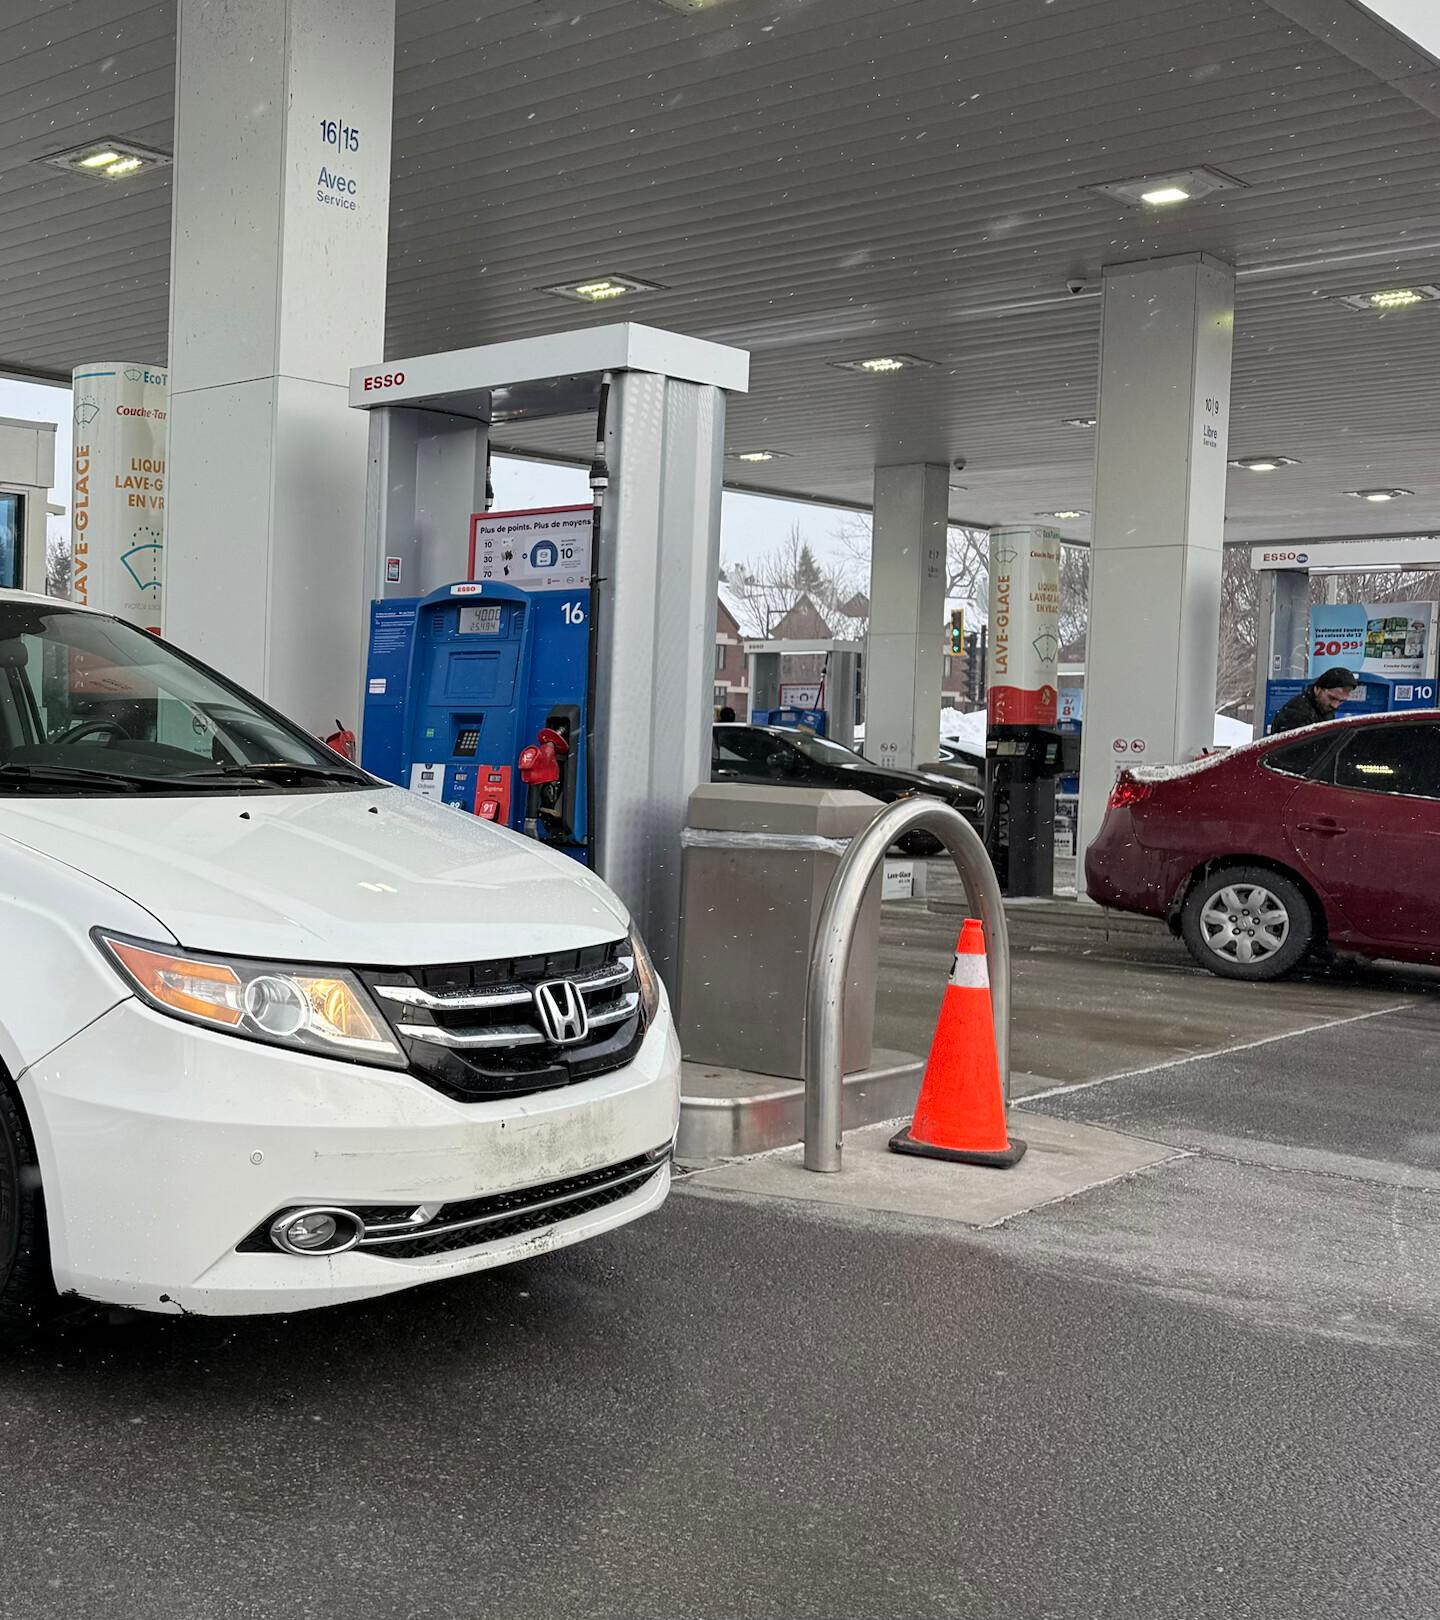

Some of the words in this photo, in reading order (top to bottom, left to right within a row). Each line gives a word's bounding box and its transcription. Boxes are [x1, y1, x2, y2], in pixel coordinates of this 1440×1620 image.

[317, 166, 356, 195] Avec
[316, 190, 356, 210] Service
[364, 372, 405, 391] ESSO
[128, 494, 146, 508] EN
[74, 444, 91, 606] LAVE-GLACE
[480, 526, 495, 534] Plus
[507, 524, 532, 534] points.
[533, 522, 550, 530] Plus
[551, 520, 561, 528] de
[562, 519, 592, 528] moyens
[560, 548, 573, 559] 10
[1263, 552, 1296, 561] ESSO
[561, 601, 585, 625] 16
[995, 575, 1011, 675] LAVE-GLACE
[1415, 686, 1432, 699] 10
[483, 804, 493, 813] 91
